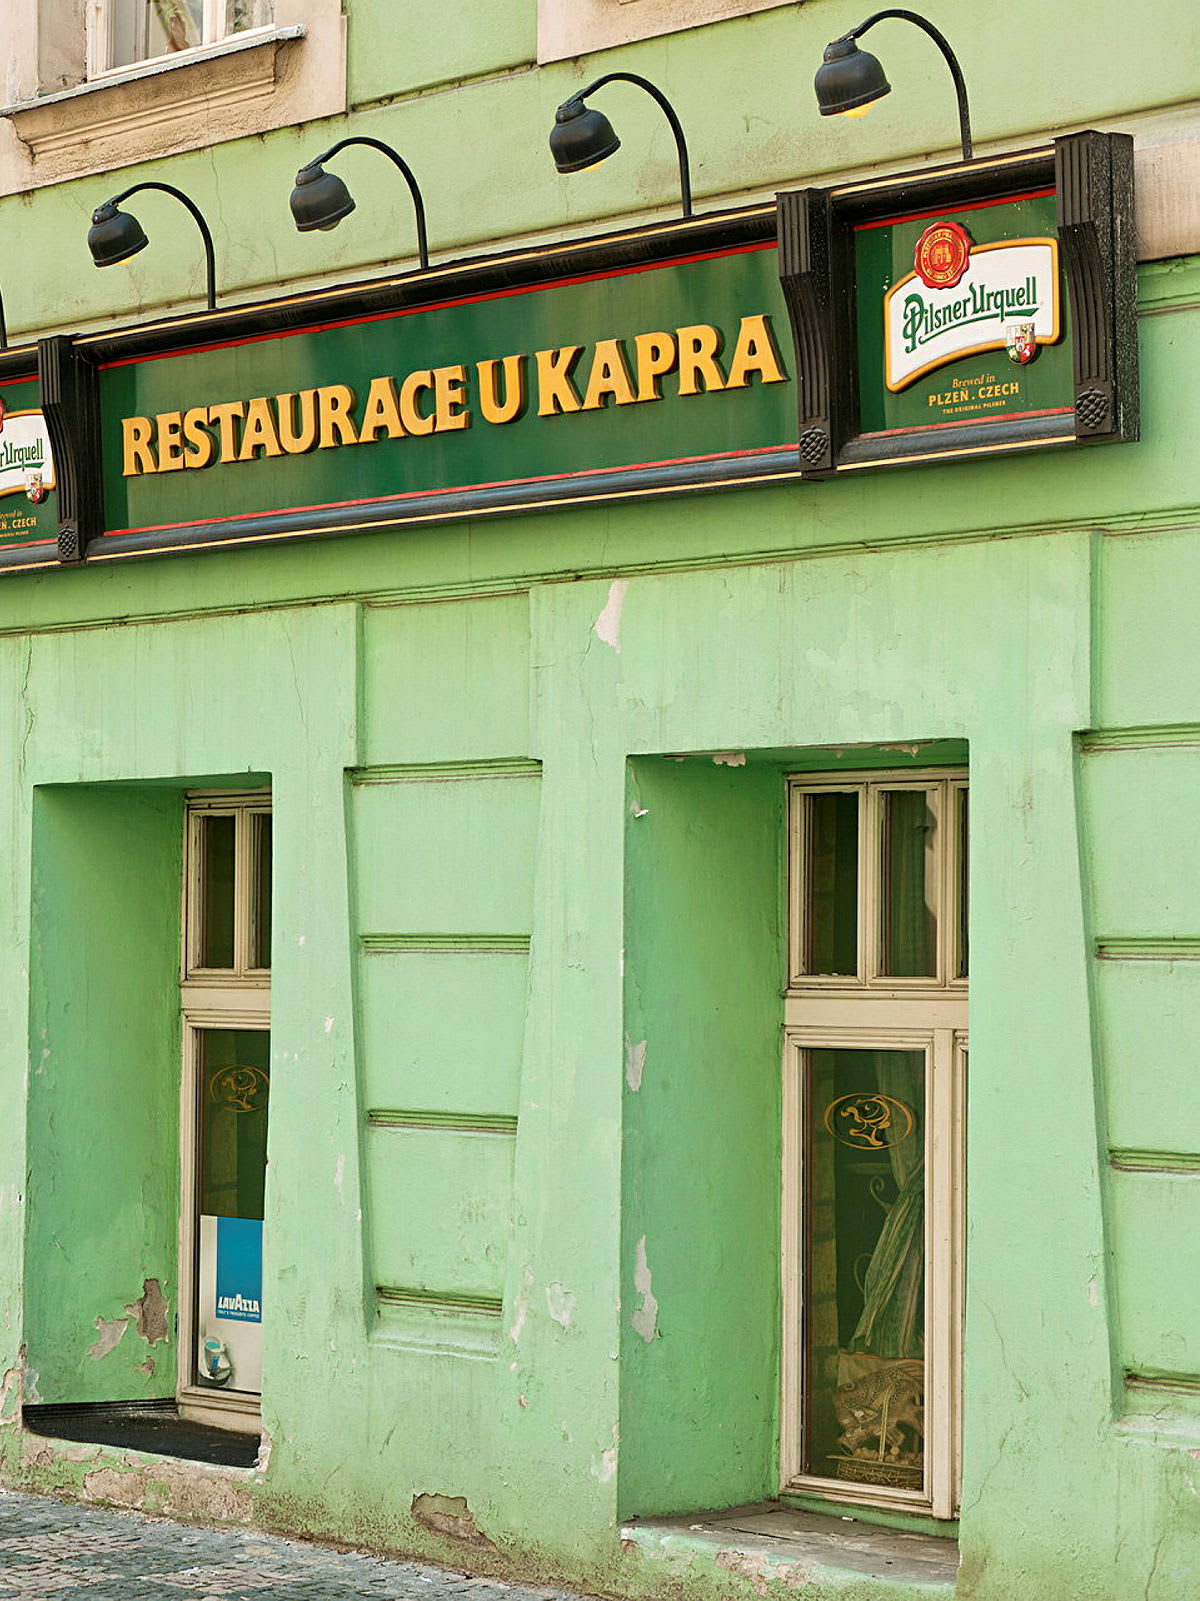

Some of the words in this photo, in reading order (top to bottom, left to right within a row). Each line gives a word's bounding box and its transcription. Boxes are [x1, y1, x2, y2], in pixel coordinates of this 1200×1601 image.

[902, 293, 971, 354] Pilsner
[969, 276, 1037, 323] Urquell
[951, 374, 985, 389] Brewed
[985, 373, 996, 383] in
[978, 382, 1020, 399] CZECH
[121, 363, 470, 477] RESTAURACE
[476, 354, 528, 424] U
[535, 313, 789, 417] KAPRA
[3, 438, 44, 472] Urquell
[12, 517, 37, 528] CZECH
[217, 1293, 260, 1313] LAVAZZA
